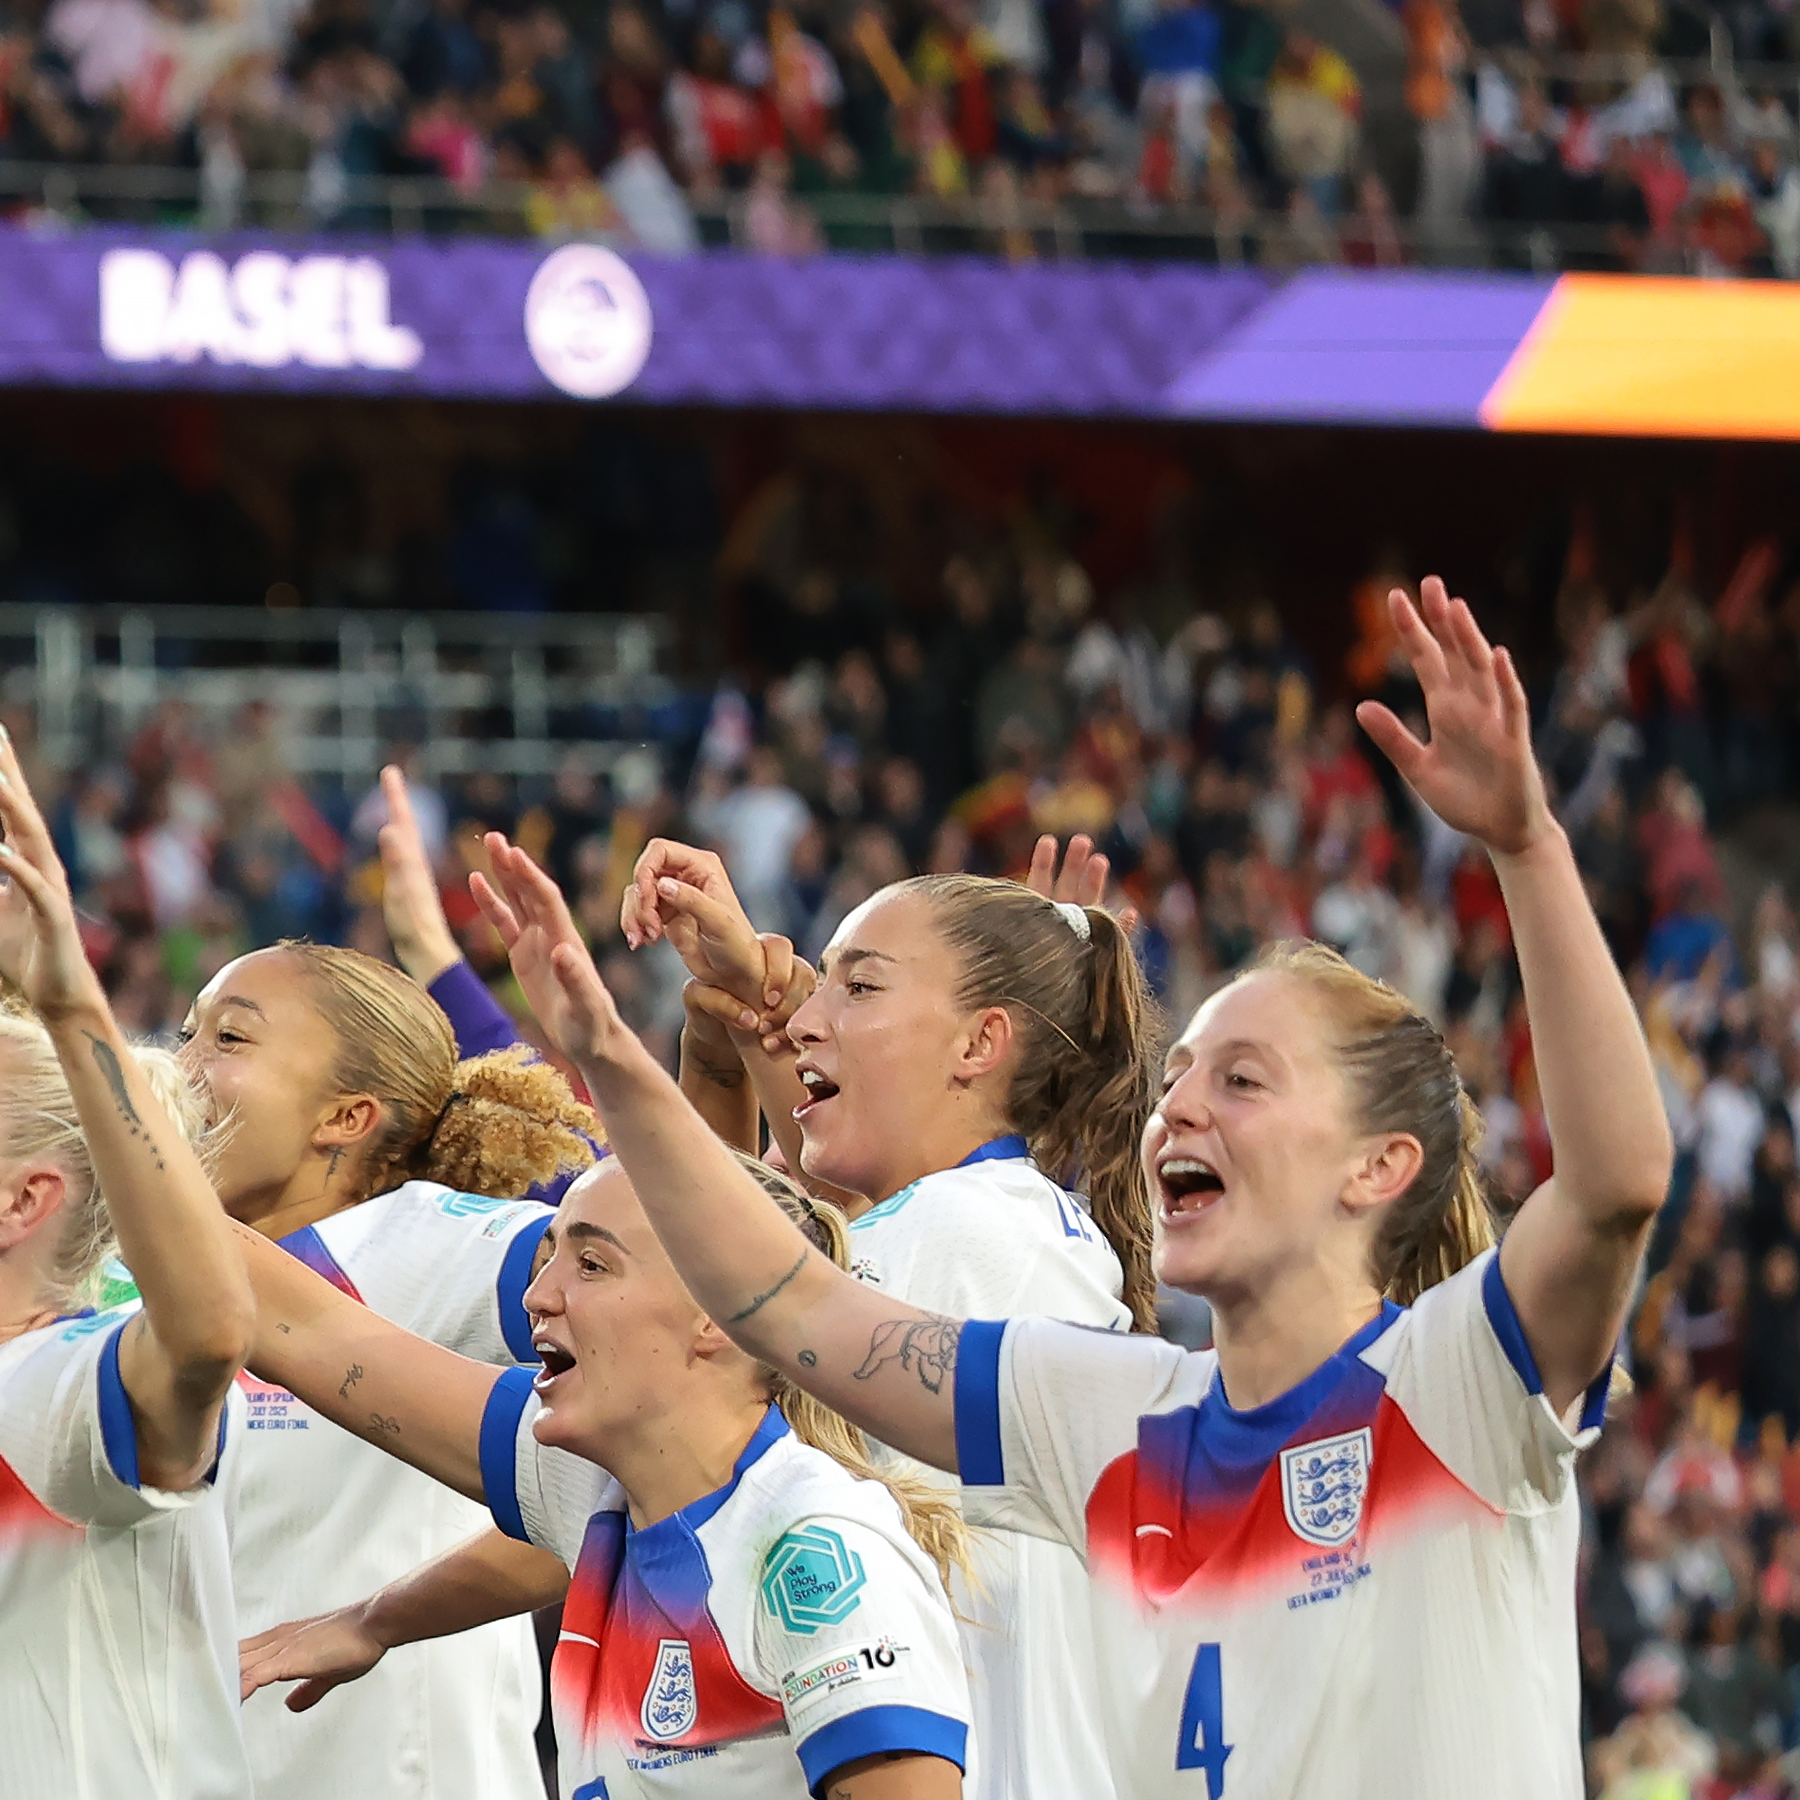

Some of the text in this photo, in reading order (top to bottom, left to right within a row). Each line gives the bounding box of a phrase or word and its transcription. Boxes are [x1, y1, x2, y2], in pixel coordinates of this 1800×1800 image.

[99, 248, 423, 370] BASEL
[790, 1573, 818, 1590] play
[858, 1646, 897, 1670] 10
